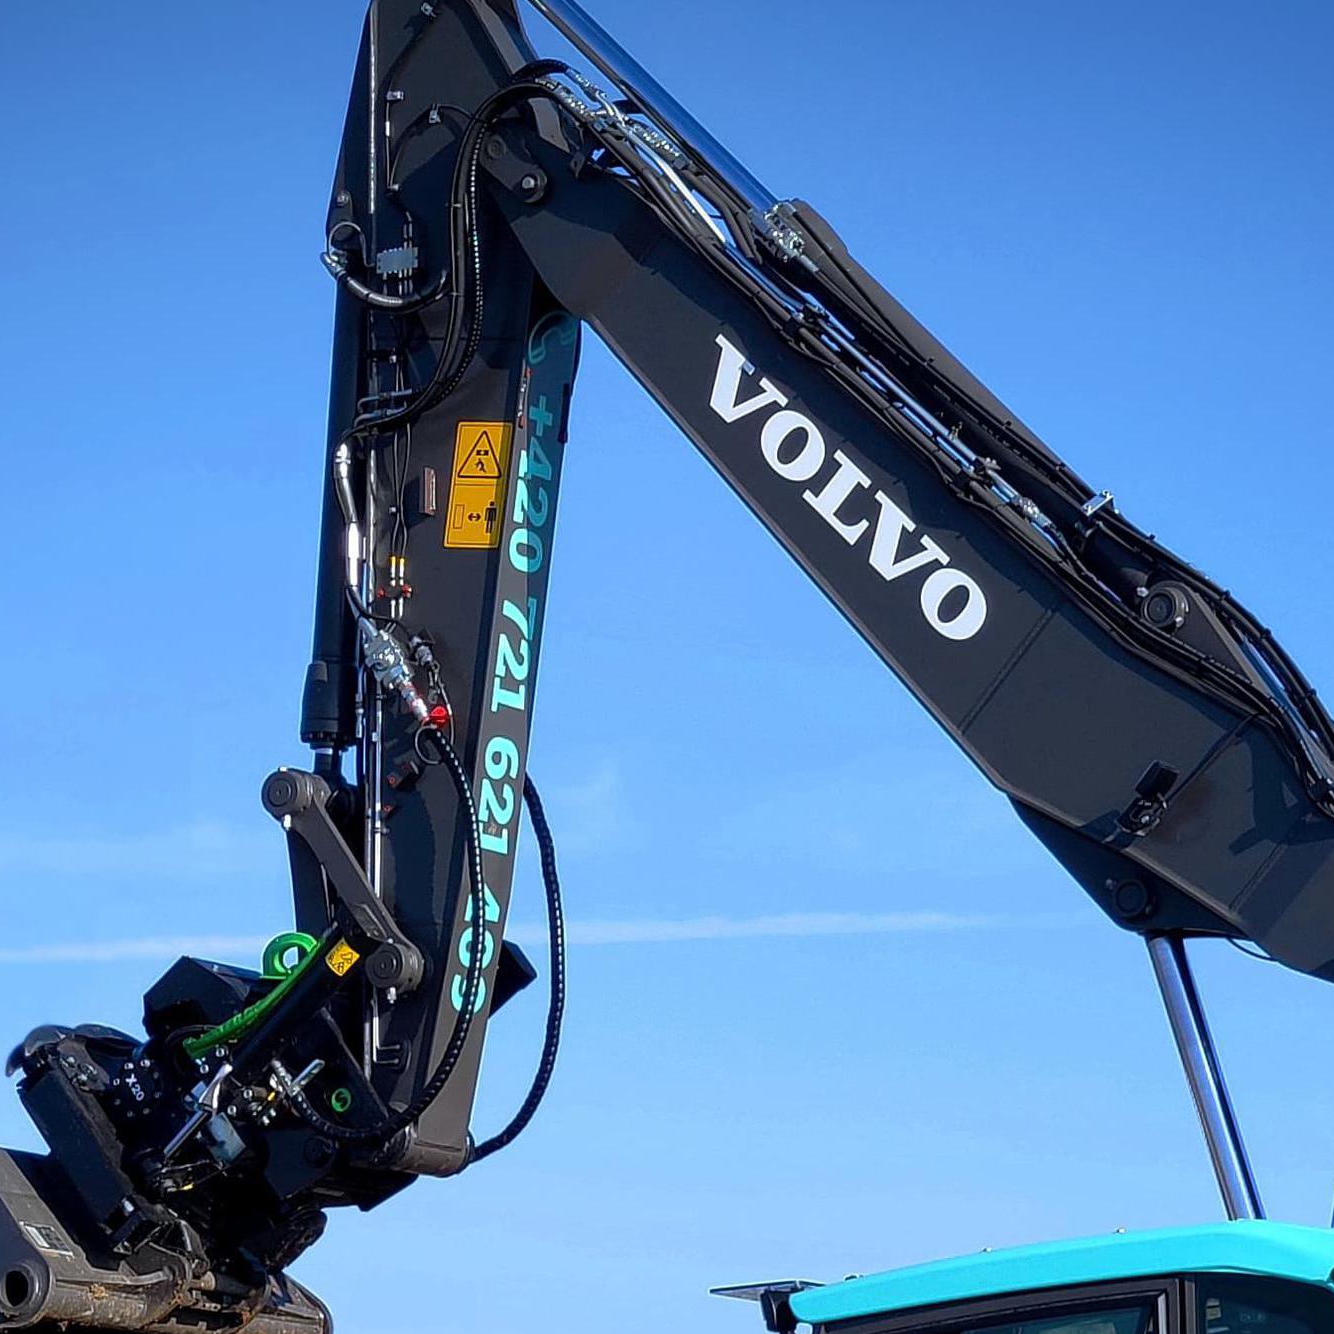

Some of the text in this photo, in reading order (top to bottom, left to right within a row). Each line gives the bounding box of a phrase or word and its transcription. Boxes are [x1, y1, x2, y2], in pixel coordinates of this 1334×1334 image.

[509, 396, 553, 573] +420
[710, 334, 987, 640] VOLVO
[491, 597, 537, 713] 721
[478, 736, 519, 855] 621
[125, 1073, 145, 1101] X20
